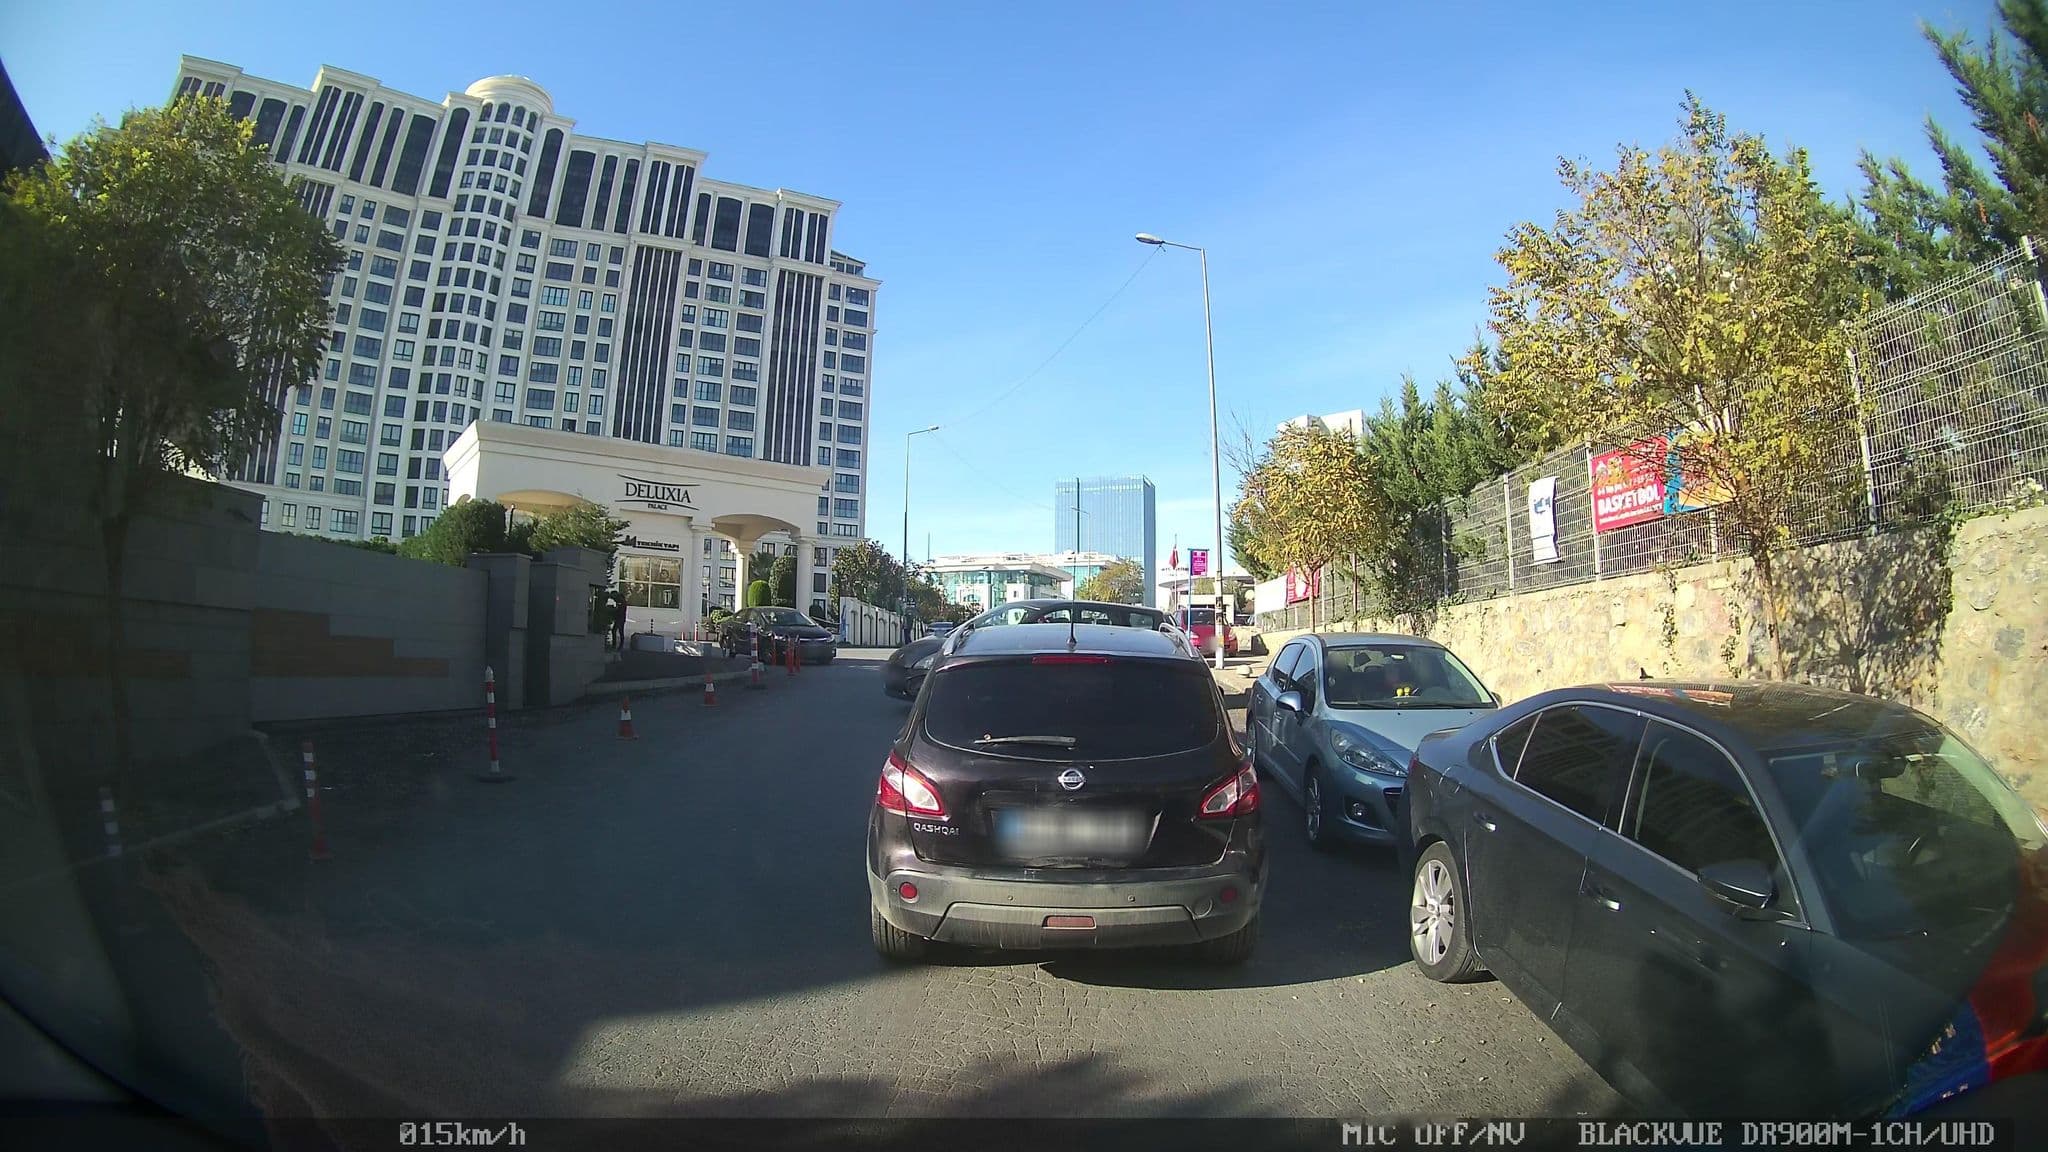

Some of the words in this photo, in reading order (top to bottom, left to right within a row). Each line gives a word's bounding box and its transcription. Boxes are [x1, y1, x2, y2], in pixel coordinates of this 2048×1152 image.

[625, 482, 691, 503] DELUXIA
[1597, 485, 1661, 514] BASKETBOL
[913, 822, 960, 836] QASHQAI
